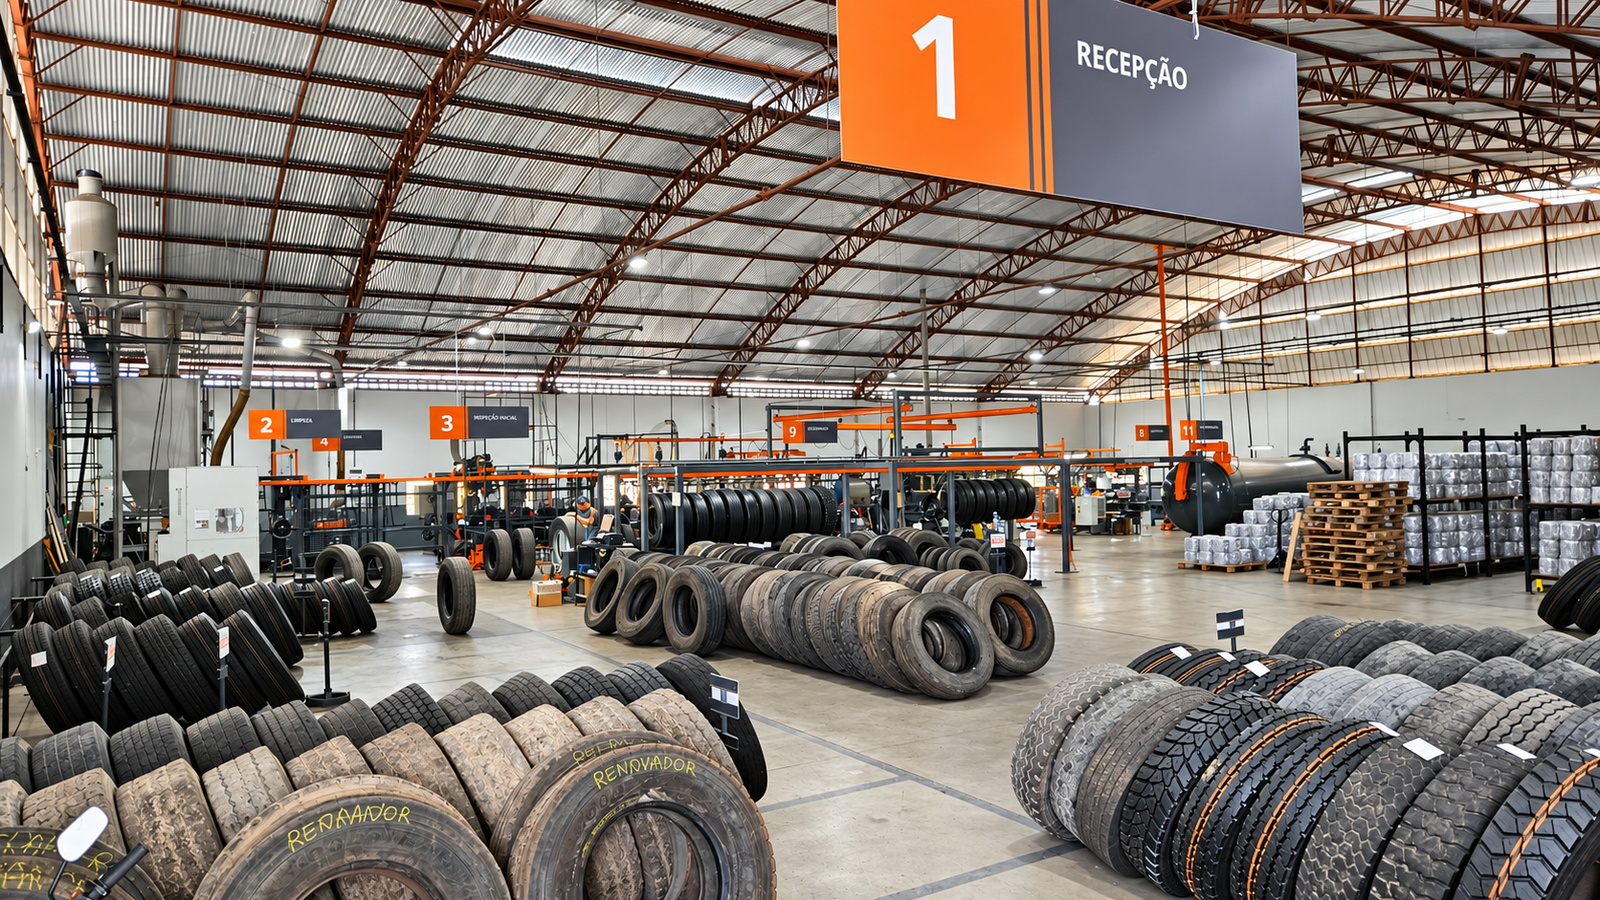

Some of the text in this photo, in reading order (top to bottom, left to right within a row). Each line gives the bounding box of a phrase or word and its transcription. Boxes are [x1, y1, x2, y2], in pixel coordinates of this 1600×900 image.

[912, 14, 956, 120] 1
[1076, 39, 1188, 90] RECEPÇÃO
[260, 417, 273, 433] 2
[441, 414, 454, 432] 3
[1183, 425, 1194, 436] 11
[789, 426, 797, 438] 9
[1139, 428, 1145, 438] 8
